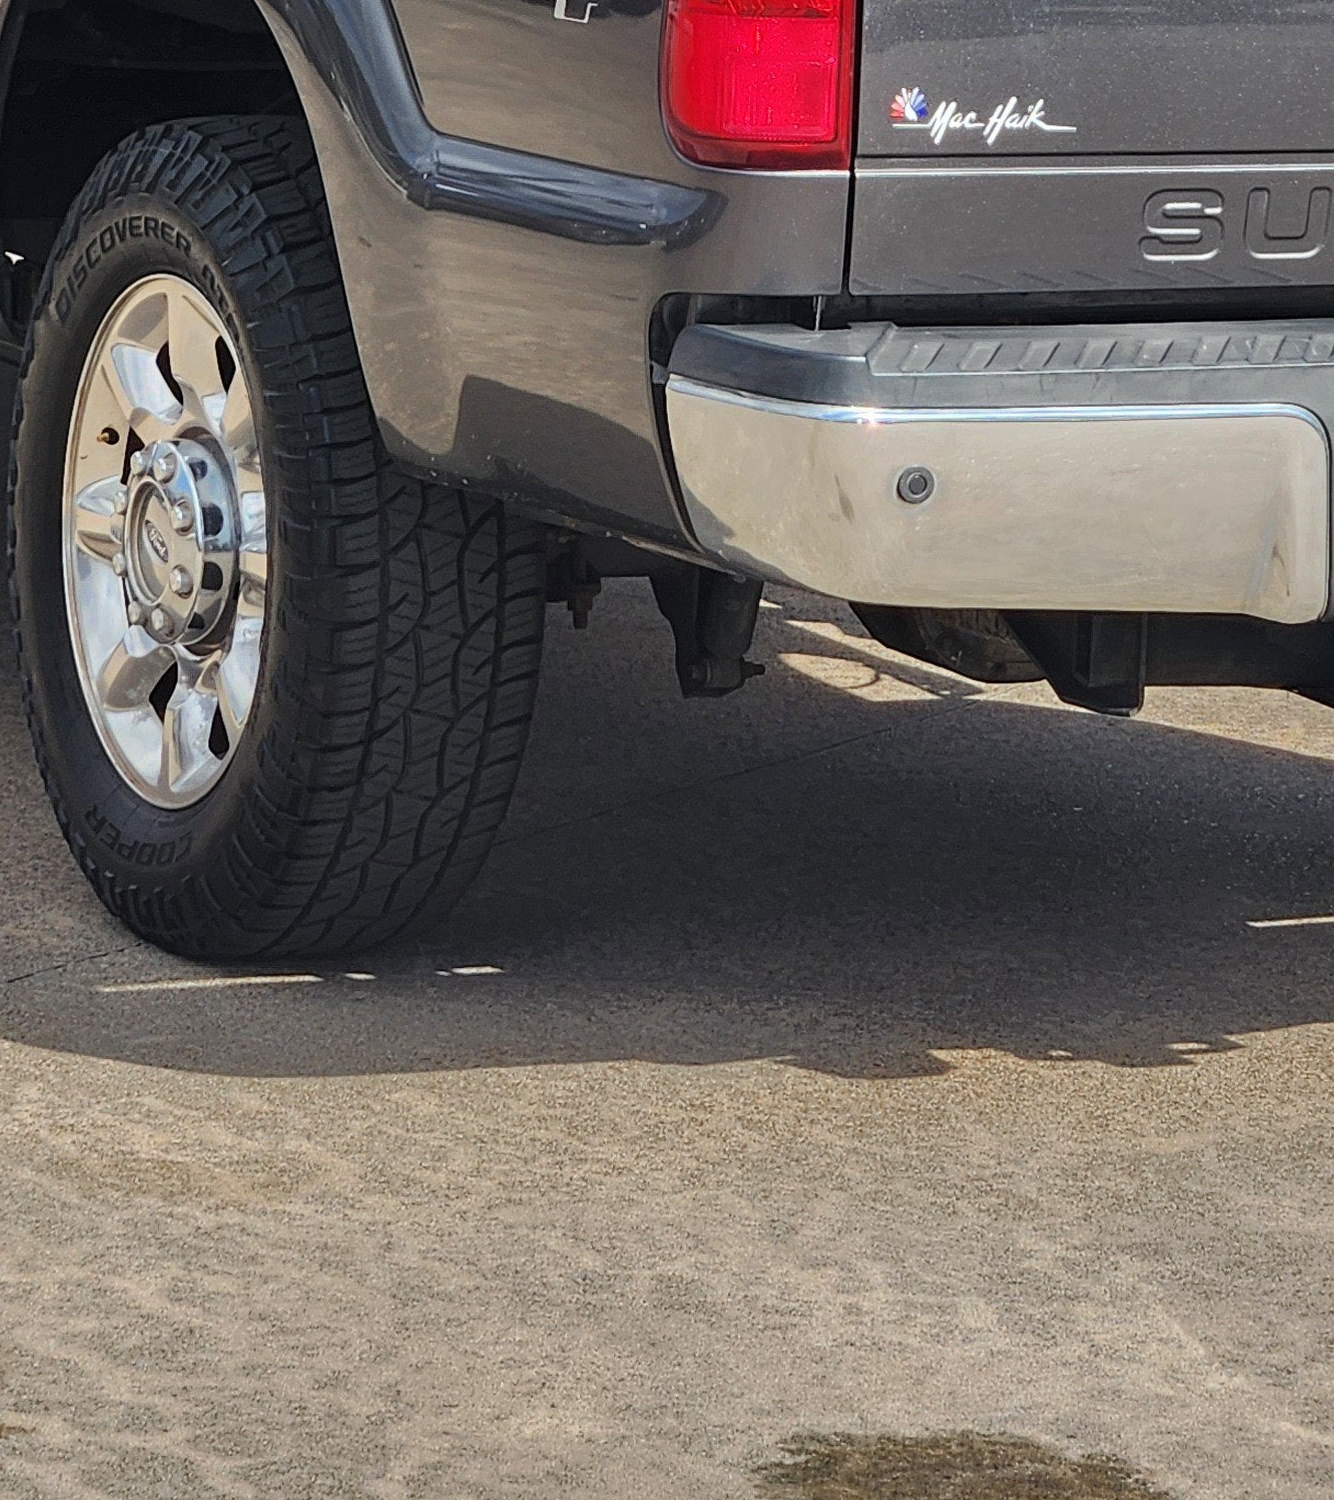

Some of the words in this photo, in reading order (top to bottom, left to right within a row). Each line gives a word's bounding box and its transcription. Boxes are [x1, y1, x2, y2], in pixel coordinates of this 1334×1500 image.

[925, 100, 985, 146] Mac
[982, 96, 1049, 146] Haik
[55, 215, 193, 323] DISCOVERER
[83, 803, 194, 866] COOPER
